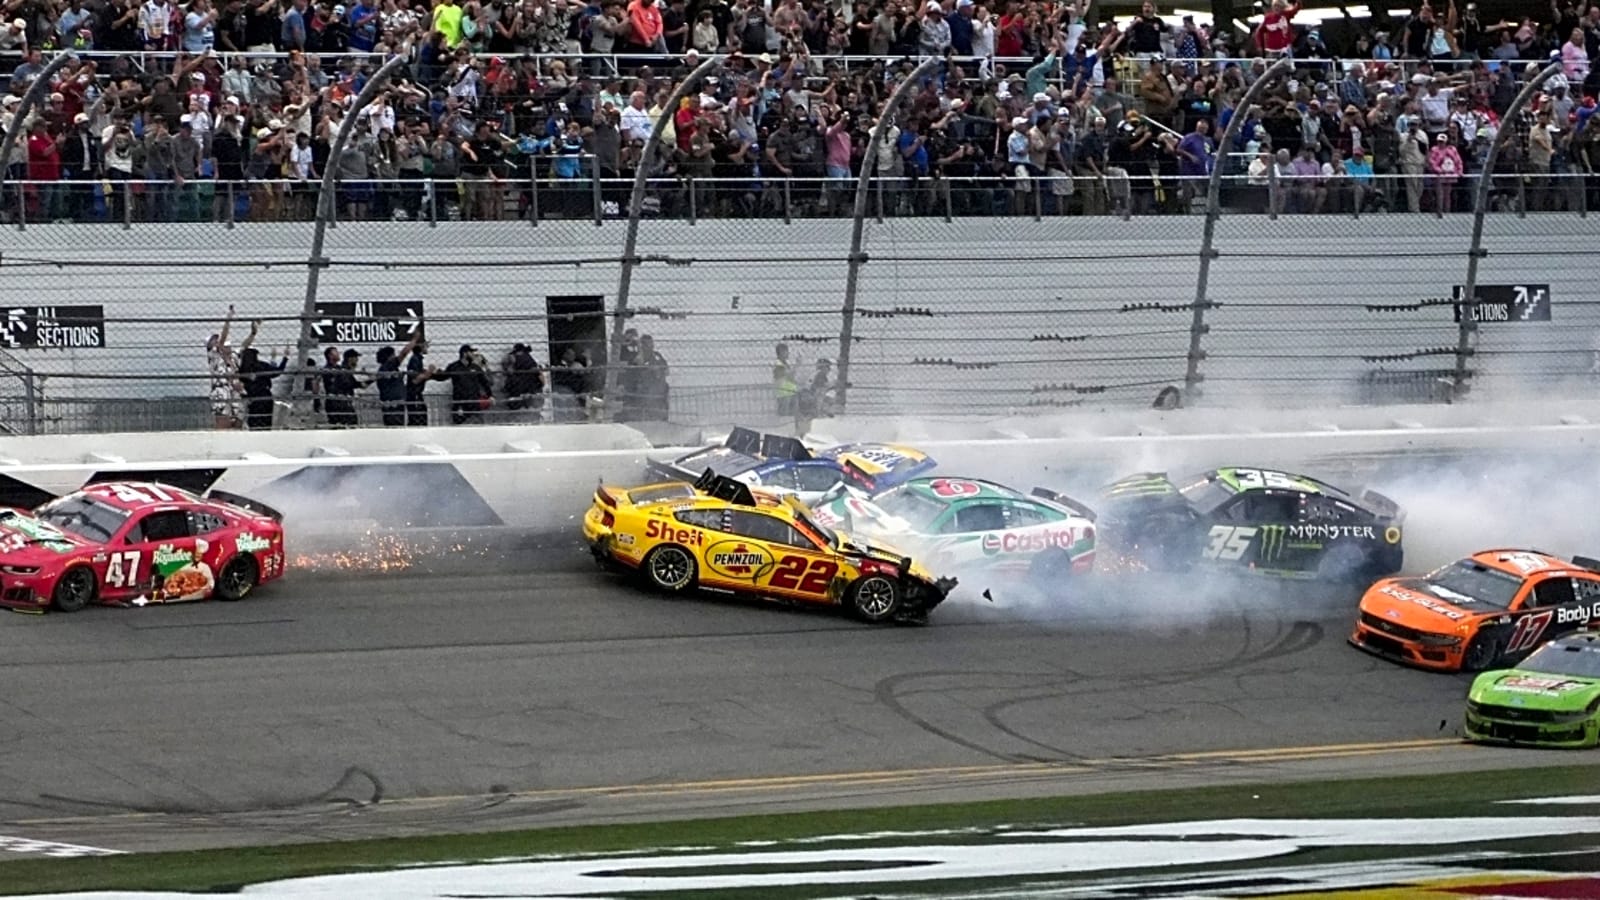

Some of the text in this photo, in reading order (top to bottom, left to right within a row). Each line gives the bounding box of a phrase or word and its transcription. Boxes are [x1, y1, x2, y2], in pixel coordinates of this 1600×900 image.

[36, 306, 60, 327] ALL
[36, 326, 100, 346] SECTIONS
[336, 321, 396, 342] SECTIONS
[930, 479, 981, 498] 6
[1235, 468, 1292, 488] 35
[109, 482, 174, 503] 47
[645, 518, 703, 547] Shell
[1003, 527, 1075, 552] Castrol
[1289, 524, 1376, 539] MONSTER
[1202, 525, 1258, 561] 35
[105, 551, 140, 588] 47
[713, 553, 763, 566] PENNZOIL
[768, 555, 839, 594] 22
[1557, 605, 1591, 624] Body
[1505, 610, 1553, 654] 17
